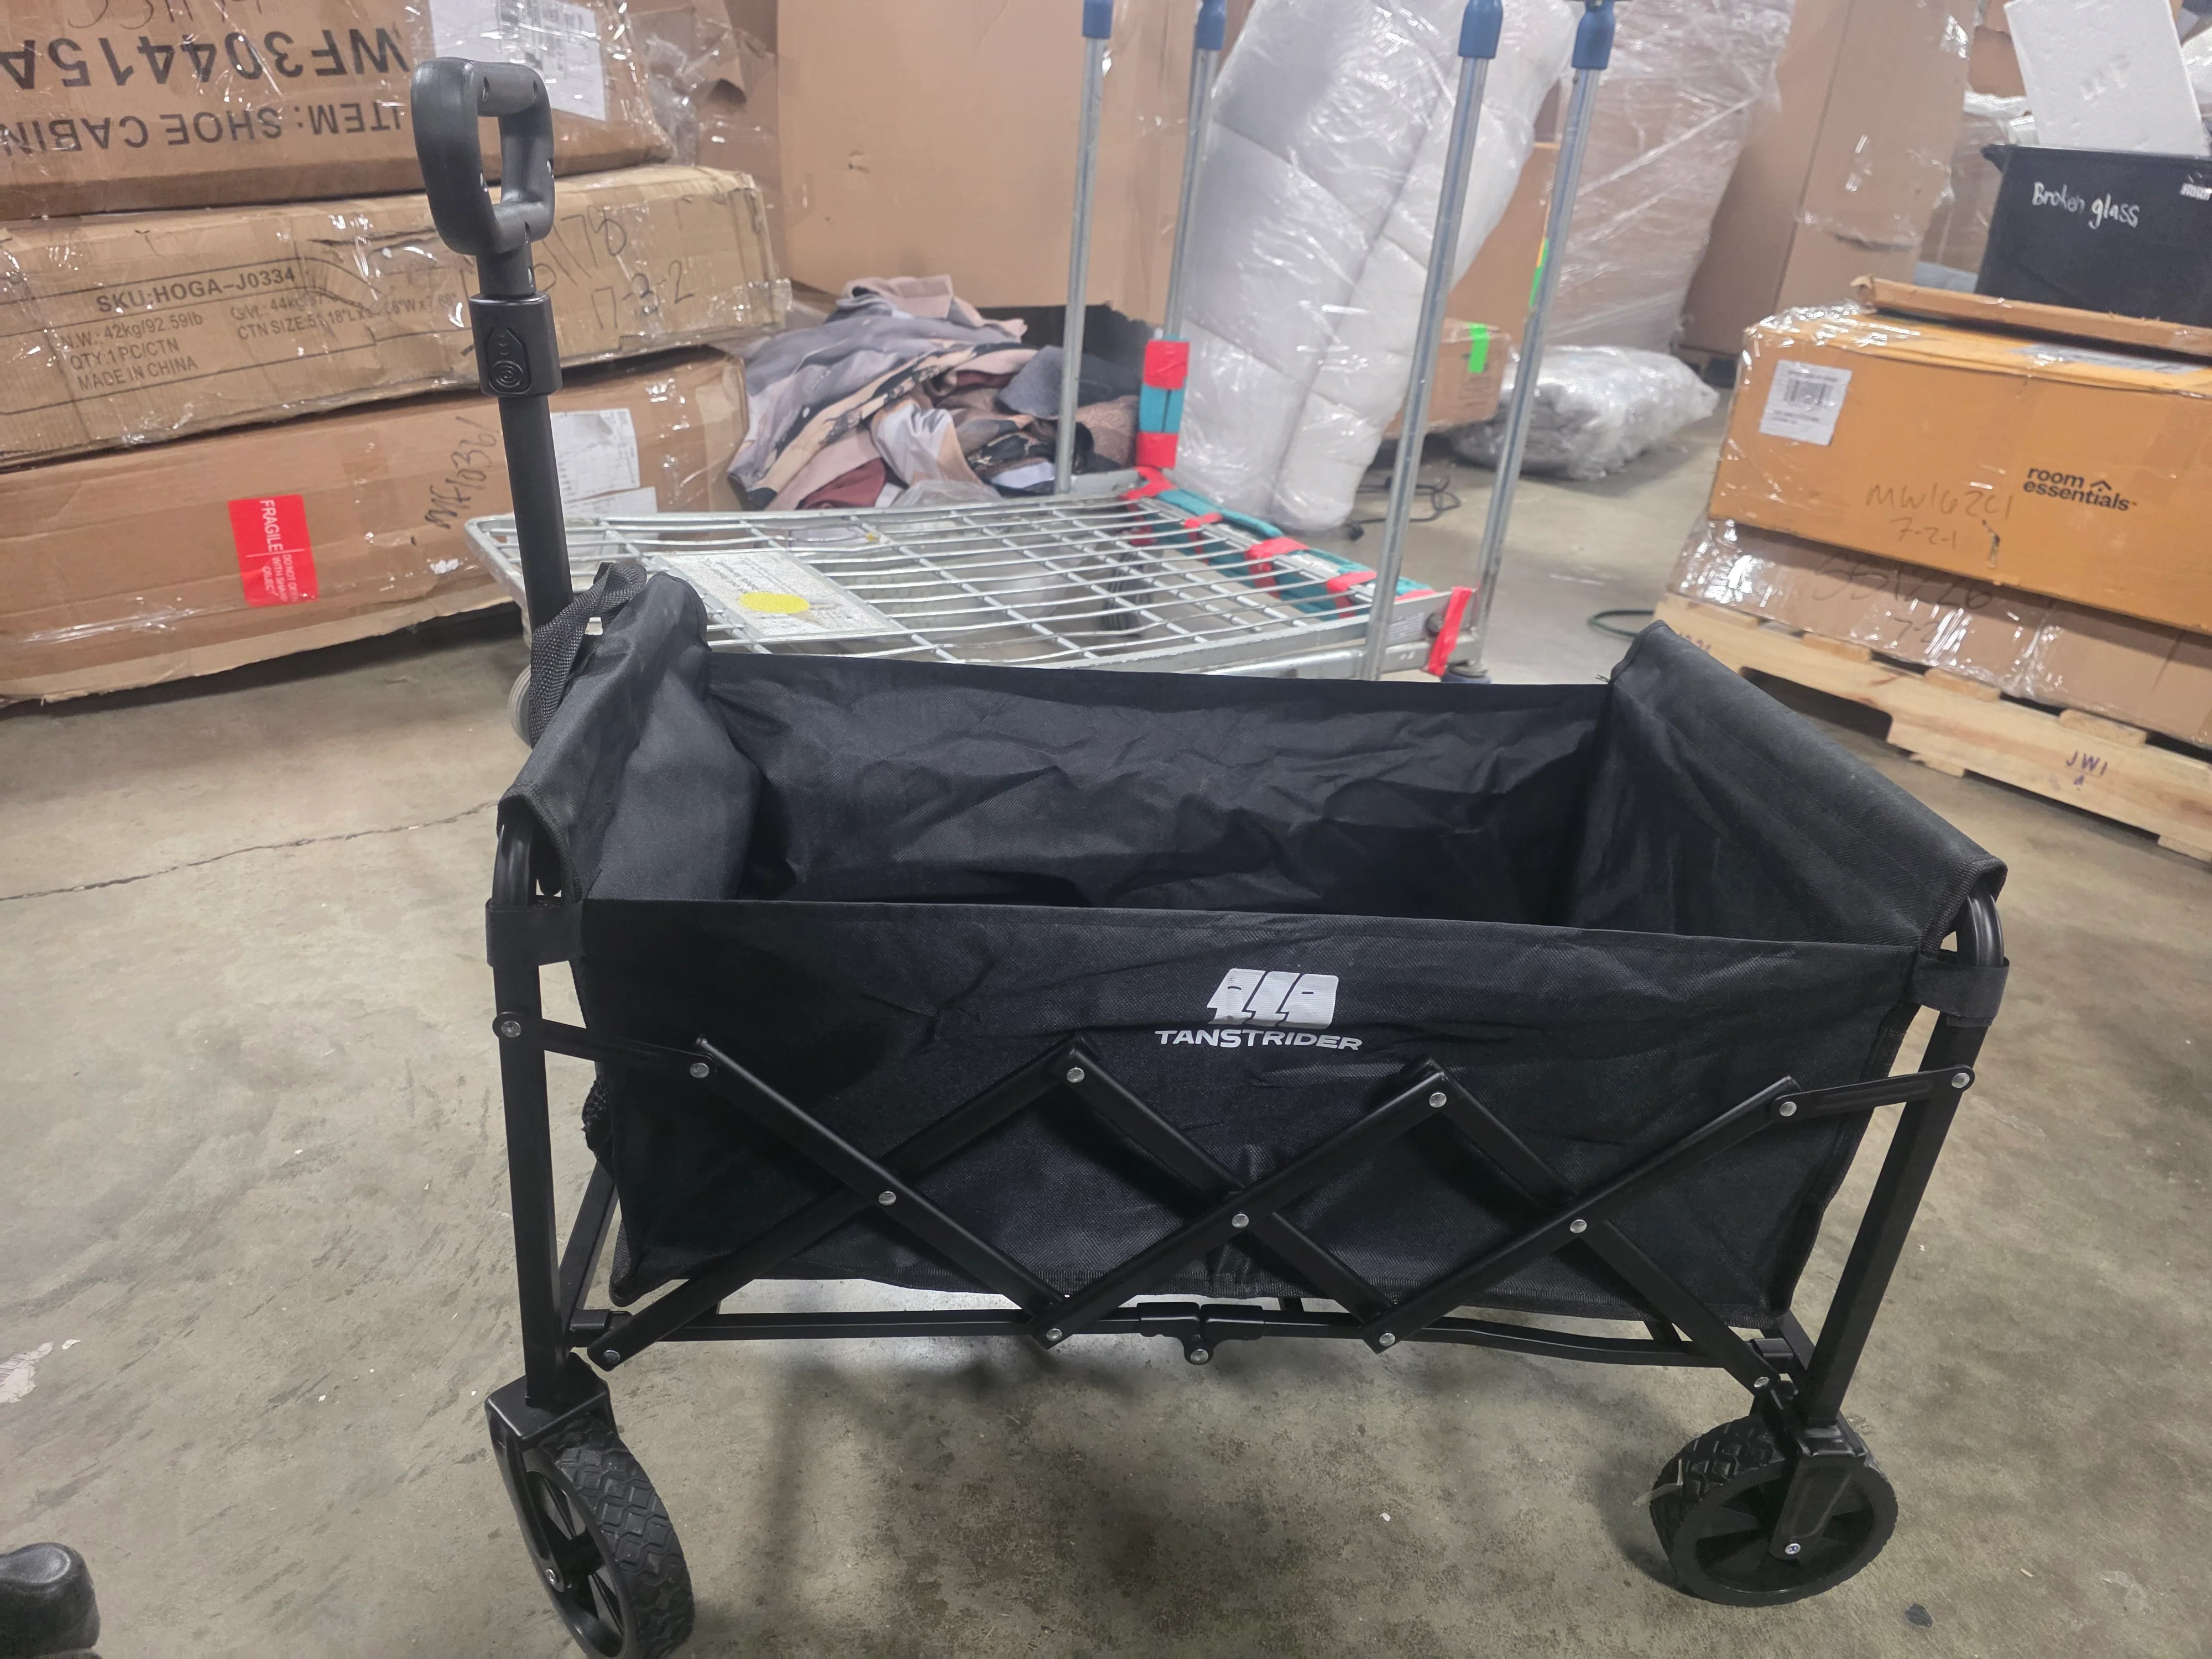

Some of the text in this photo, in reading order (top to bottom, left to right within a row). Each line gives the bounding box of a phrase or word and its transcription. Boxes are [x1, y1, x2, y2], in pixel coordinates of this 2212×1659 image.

[159, 107, 283, 146] SHOE
[293, 101, 401, 135] ITEM:
[2031, 181, 2141, 230] Broken glass
[96, 267, 295, 312] SKU:HOGA-J0334
[104, 311, 204, 340] 42kg/92.59lb
[237, 322, 269, 340] CTN
[77, 356, 199, 392] MADE IN CHINA
[2027, 467, 2085, 489] room
[2023, 481, 2130, 512] essentials
[259, 499, 285, 554] FRAGILE
[1154, 1029, 1363, 1051] TANSTRIDER
